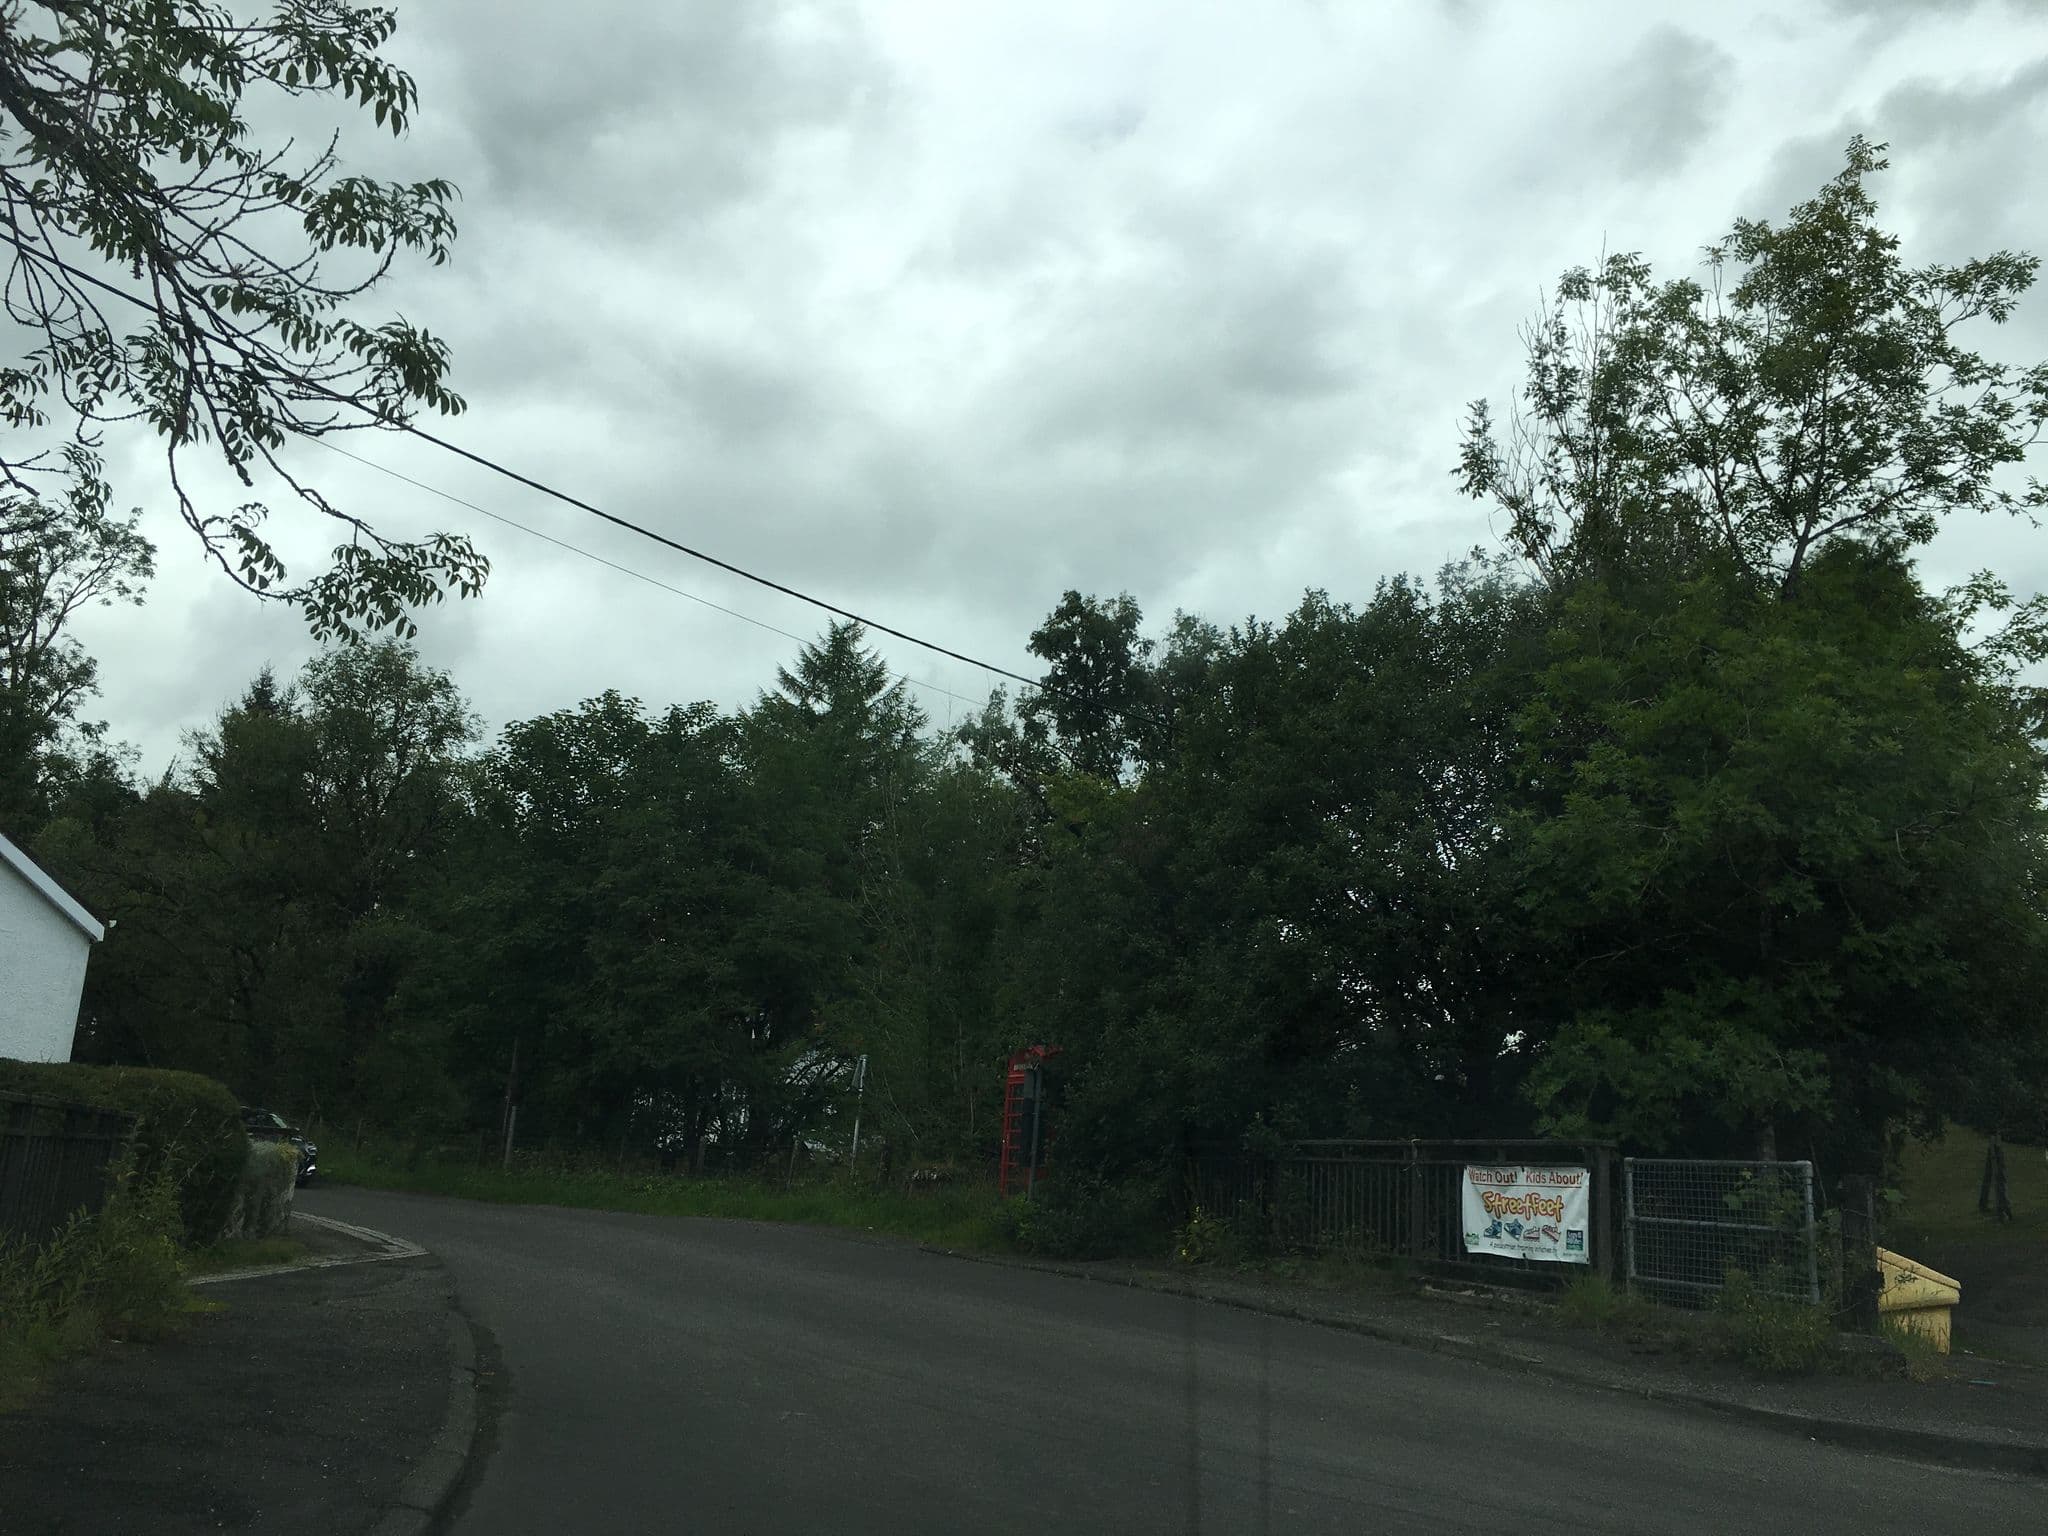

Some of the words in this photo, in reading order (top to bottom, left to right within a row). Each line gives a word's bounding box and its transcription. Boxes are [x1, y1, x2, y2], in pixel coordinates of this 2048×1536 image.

[1467, 1168, 1493, 1182] Watch
[1495, 1170, 1518, 1183] Out!
[1526, 1170, 1547, 1184] Kids
[1549, 1171, 1584, 1185] About!
